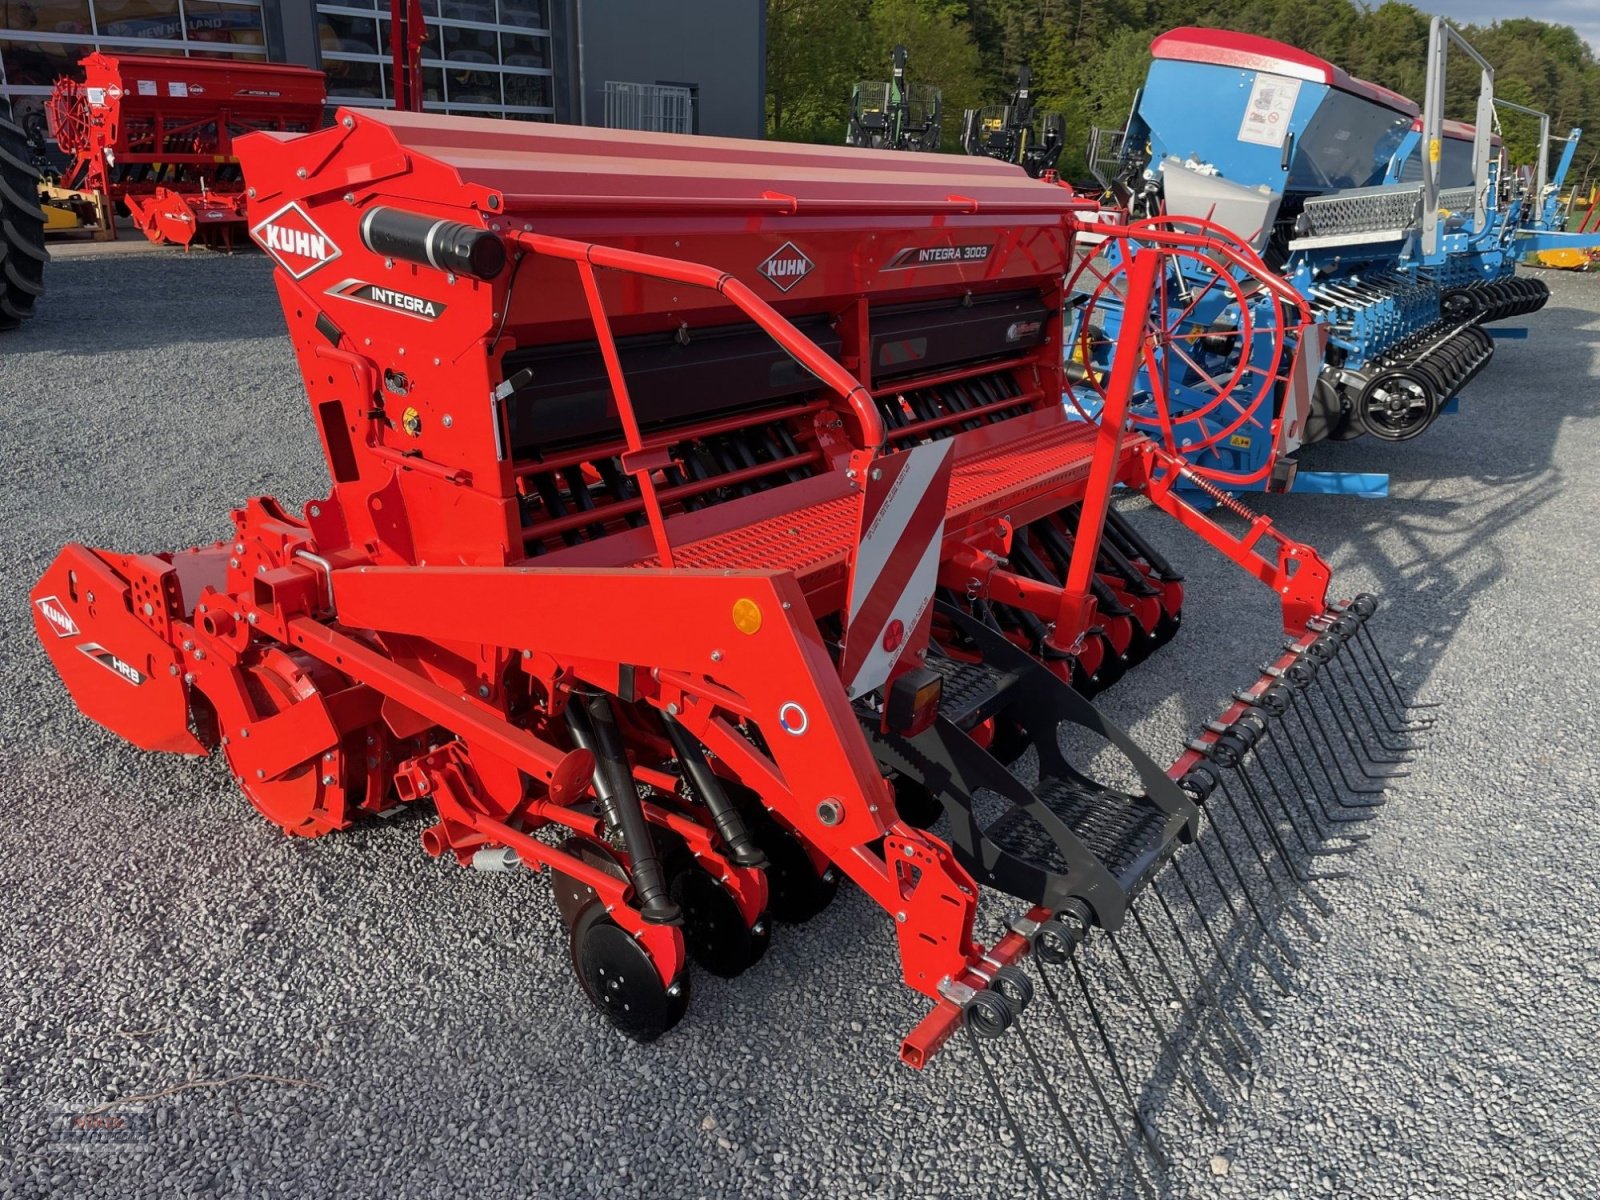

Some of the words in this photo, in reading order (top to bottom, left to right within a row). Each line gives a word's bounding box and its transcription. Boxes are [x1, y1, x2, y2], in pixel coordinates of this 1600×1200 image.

[167, 19, 222, 35] HOLAND
[267, 224, 326, 261] KUHN
[919, 247, 962, 262] INTEGRA
[963, 246, 988, 260] 3003
[767, 258, 807, 277] KUHN
[371, 286, 436, 317] INTEGRA
[41, 602, 73, 633] KUHN
[112, 656, 140, 683] HRB
